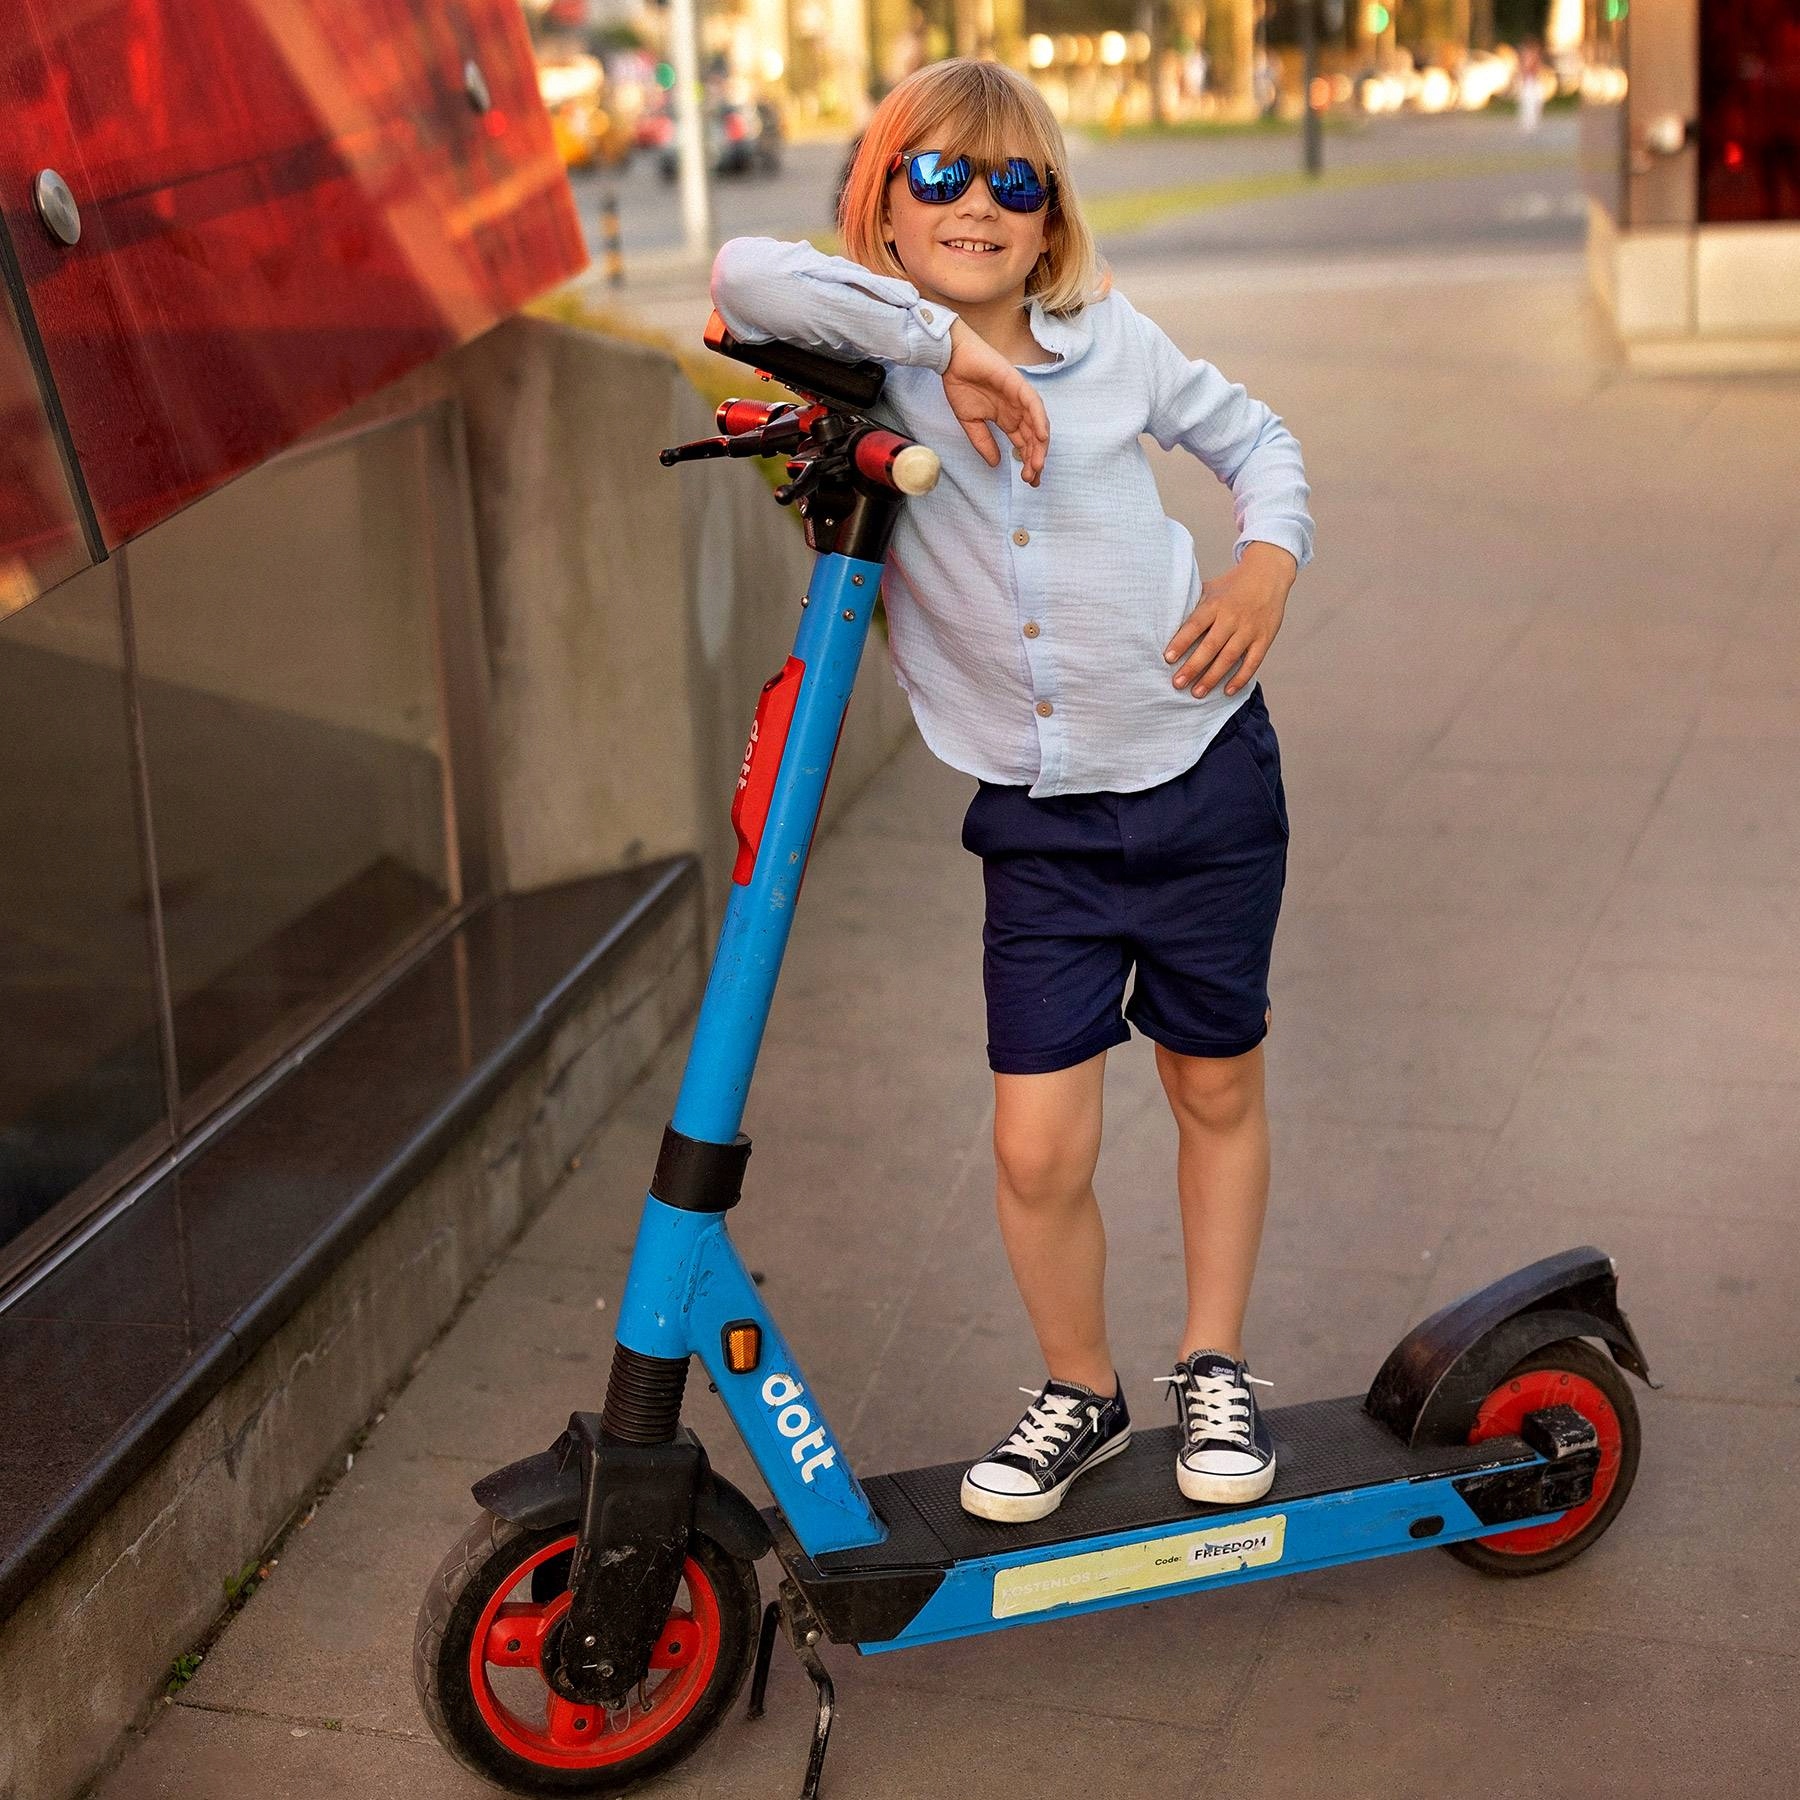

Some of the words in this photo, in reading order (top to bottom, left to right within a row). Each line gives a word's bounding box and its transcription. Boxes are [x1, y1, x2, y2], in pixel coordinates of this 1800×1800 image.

[738, 720, 759, 790] dott
[762, 1373, 836, 1484] dott
[1154, 1555, 1182, 1566] Code:
[1194, 1537, 1266, 1561] FREEDOM
